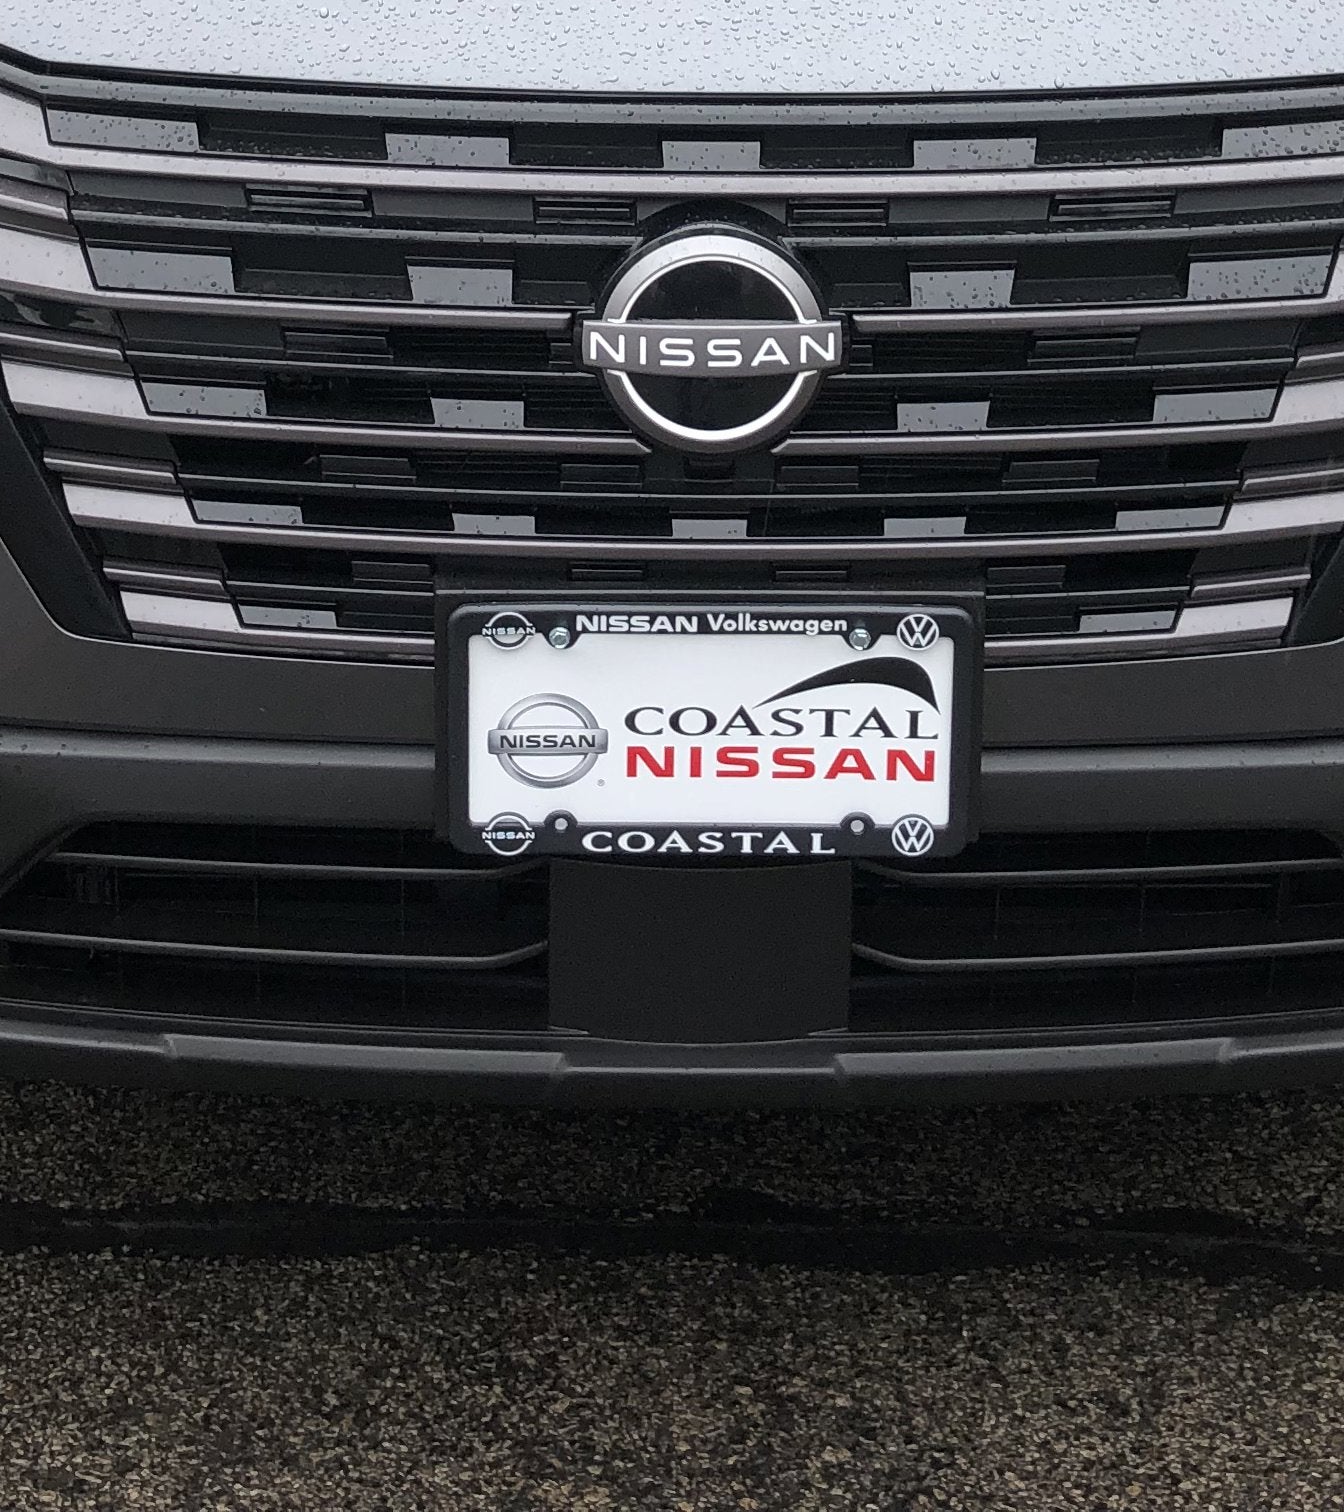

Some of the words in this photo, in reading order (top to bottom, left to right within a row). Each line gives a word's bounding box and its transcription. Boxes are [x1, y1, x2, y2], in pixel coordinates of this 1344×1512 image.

[589, 331, 835, 368] NISSAN
[482, 626, 536, 636] NISSAN
[576, 614, 698, 632] NISSAN
[707, 612, 848, 636] Volkswagen
[624, 704, 939, 740] COASTAL
[499, 734, 596, 749] NISSAN
[626, 746, 935, 781] NISSAN
[482, 830, 536, 840] NISSAN
[581, 831, 836, 853] COASTAL
